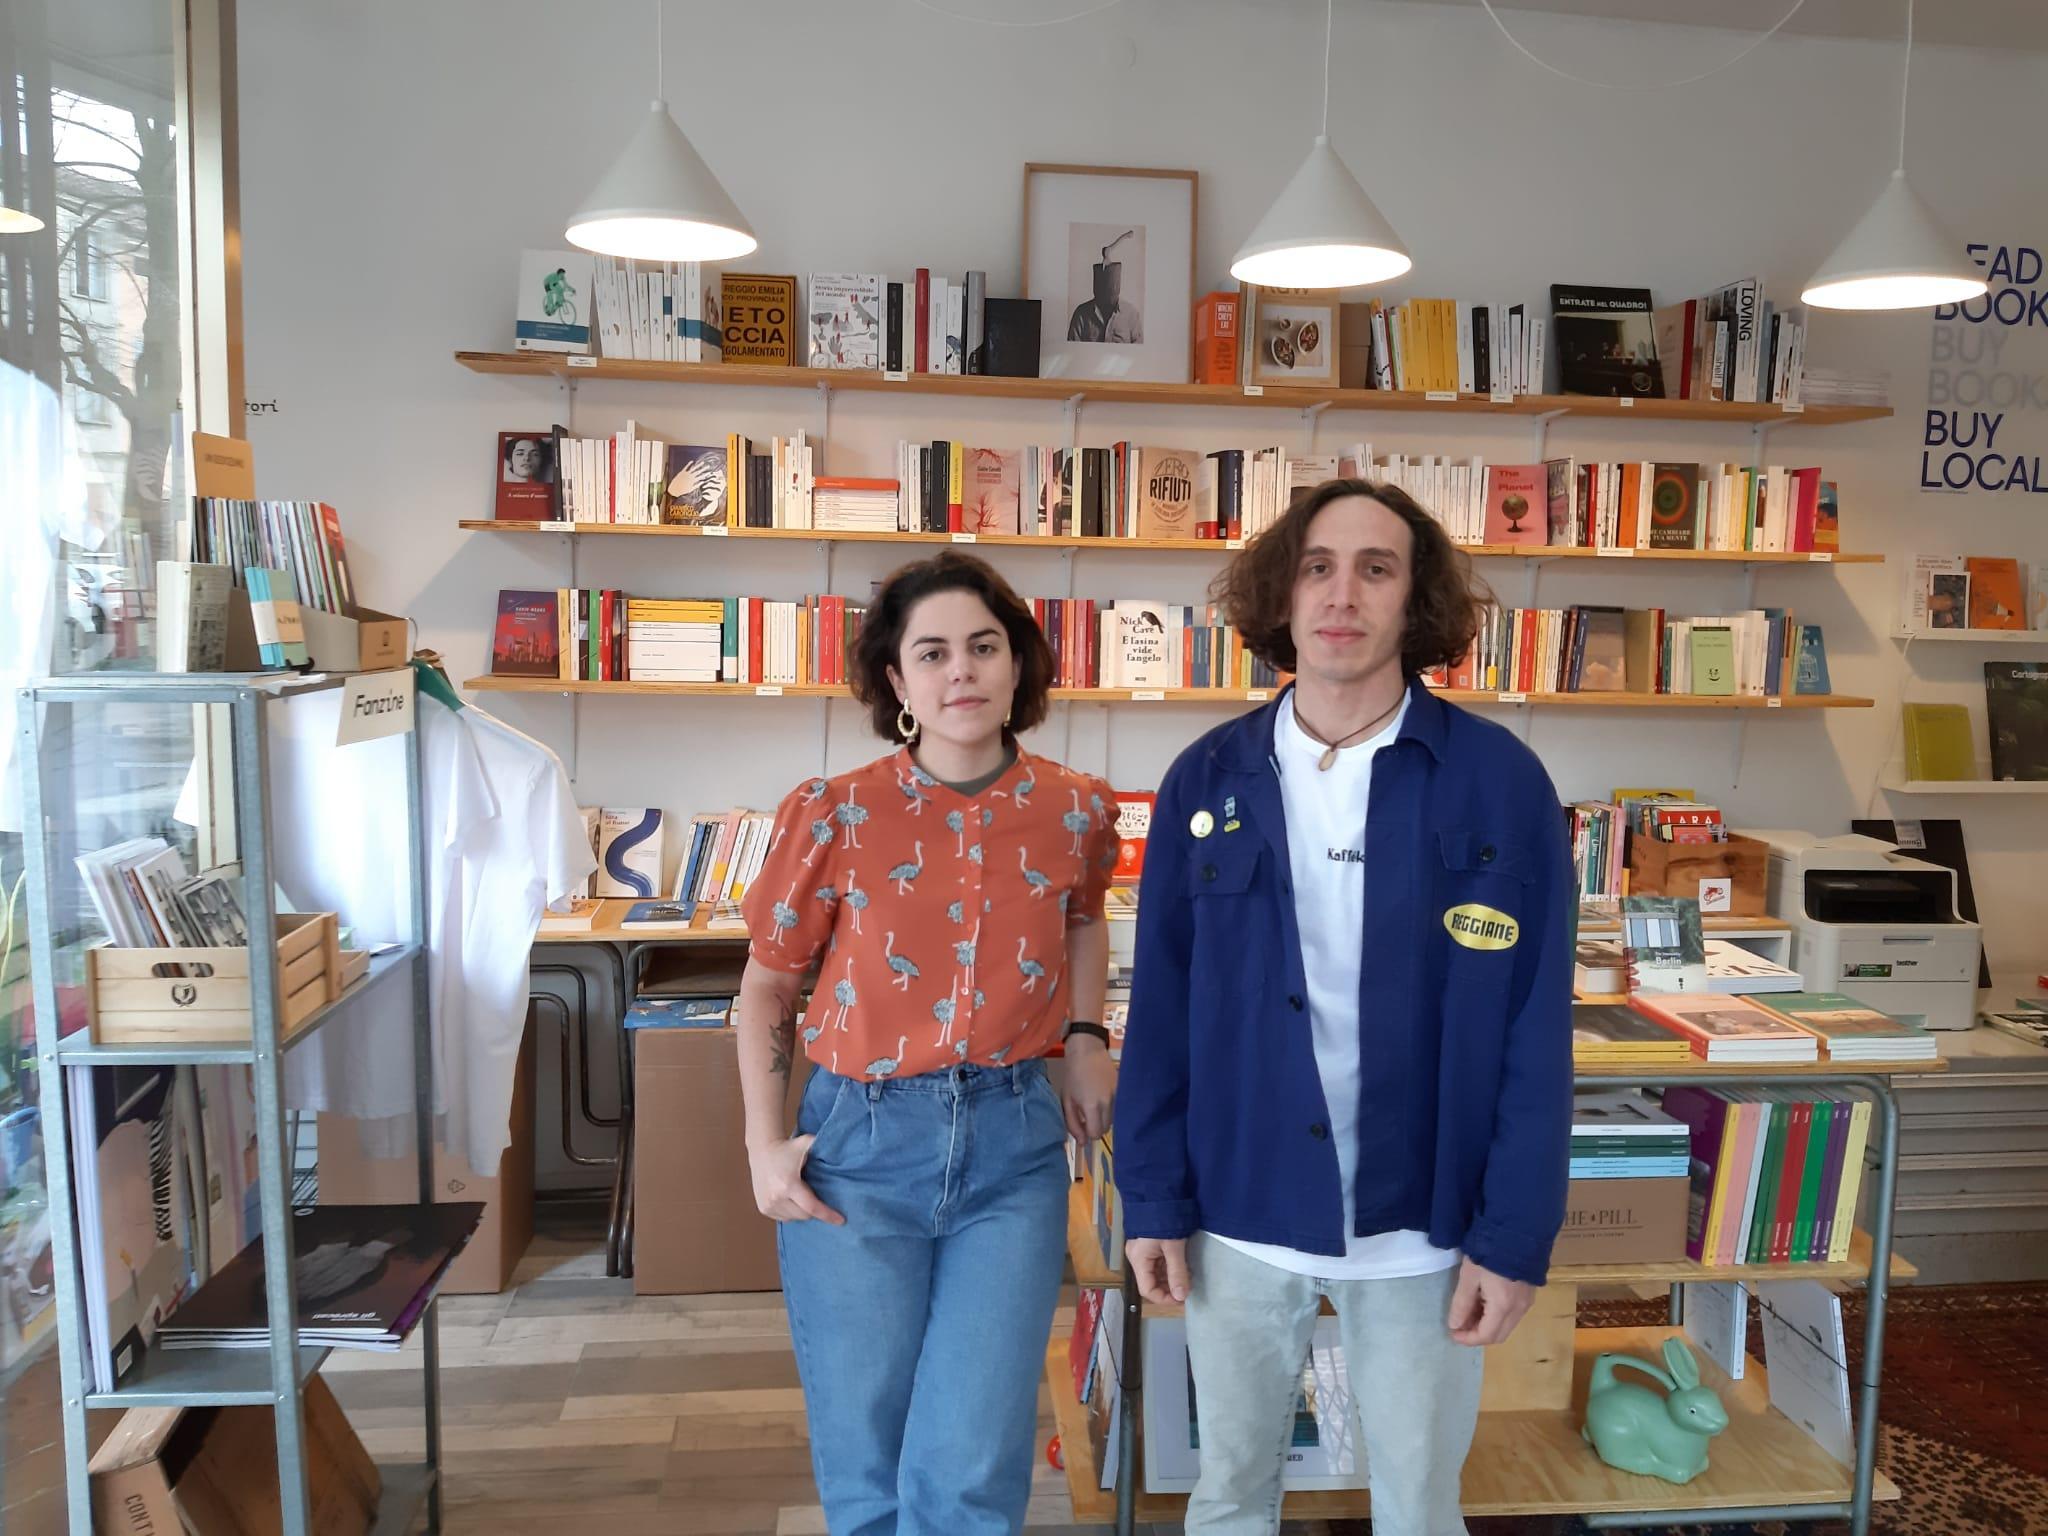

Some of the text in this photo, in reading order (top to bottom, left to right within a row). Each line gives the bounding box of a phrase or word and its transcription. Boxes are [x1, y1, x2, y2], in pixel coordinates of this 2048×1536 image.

[724, 284, 785, 295] REGGIO EMILIA
[1559, 297, 1596, 308] ENTRATE
[1738, 287, 1755, 342] LOVING
[724, 326, 785, 345] CCIA
[1931, 325, 2009, 364] BUY
[1925, 410, 2004, 449] BUY
[1154, 457, 1190, 479] ZERO
[1921, 451, 2048, 493] LOCAL
[1149, 476, 1192, 502] RIFIUTI
[1498, 483, 1534, 491] Planet
[1120, 616, 1143, 625] Nick
[1132, 626, 1154, 634] Cave
[1122, 635, 1129, 645] E
[1132, 646, 1153, 654] vide
[353, 689, 404, 719] Fanzine
[1450, 912, 1514, 943] REGGIANE
[1655, 956, 1682, 965] Berlin
[1599, 1208, 1638, 1225] PILL
[124, 1493, 156, 1536] CONT
